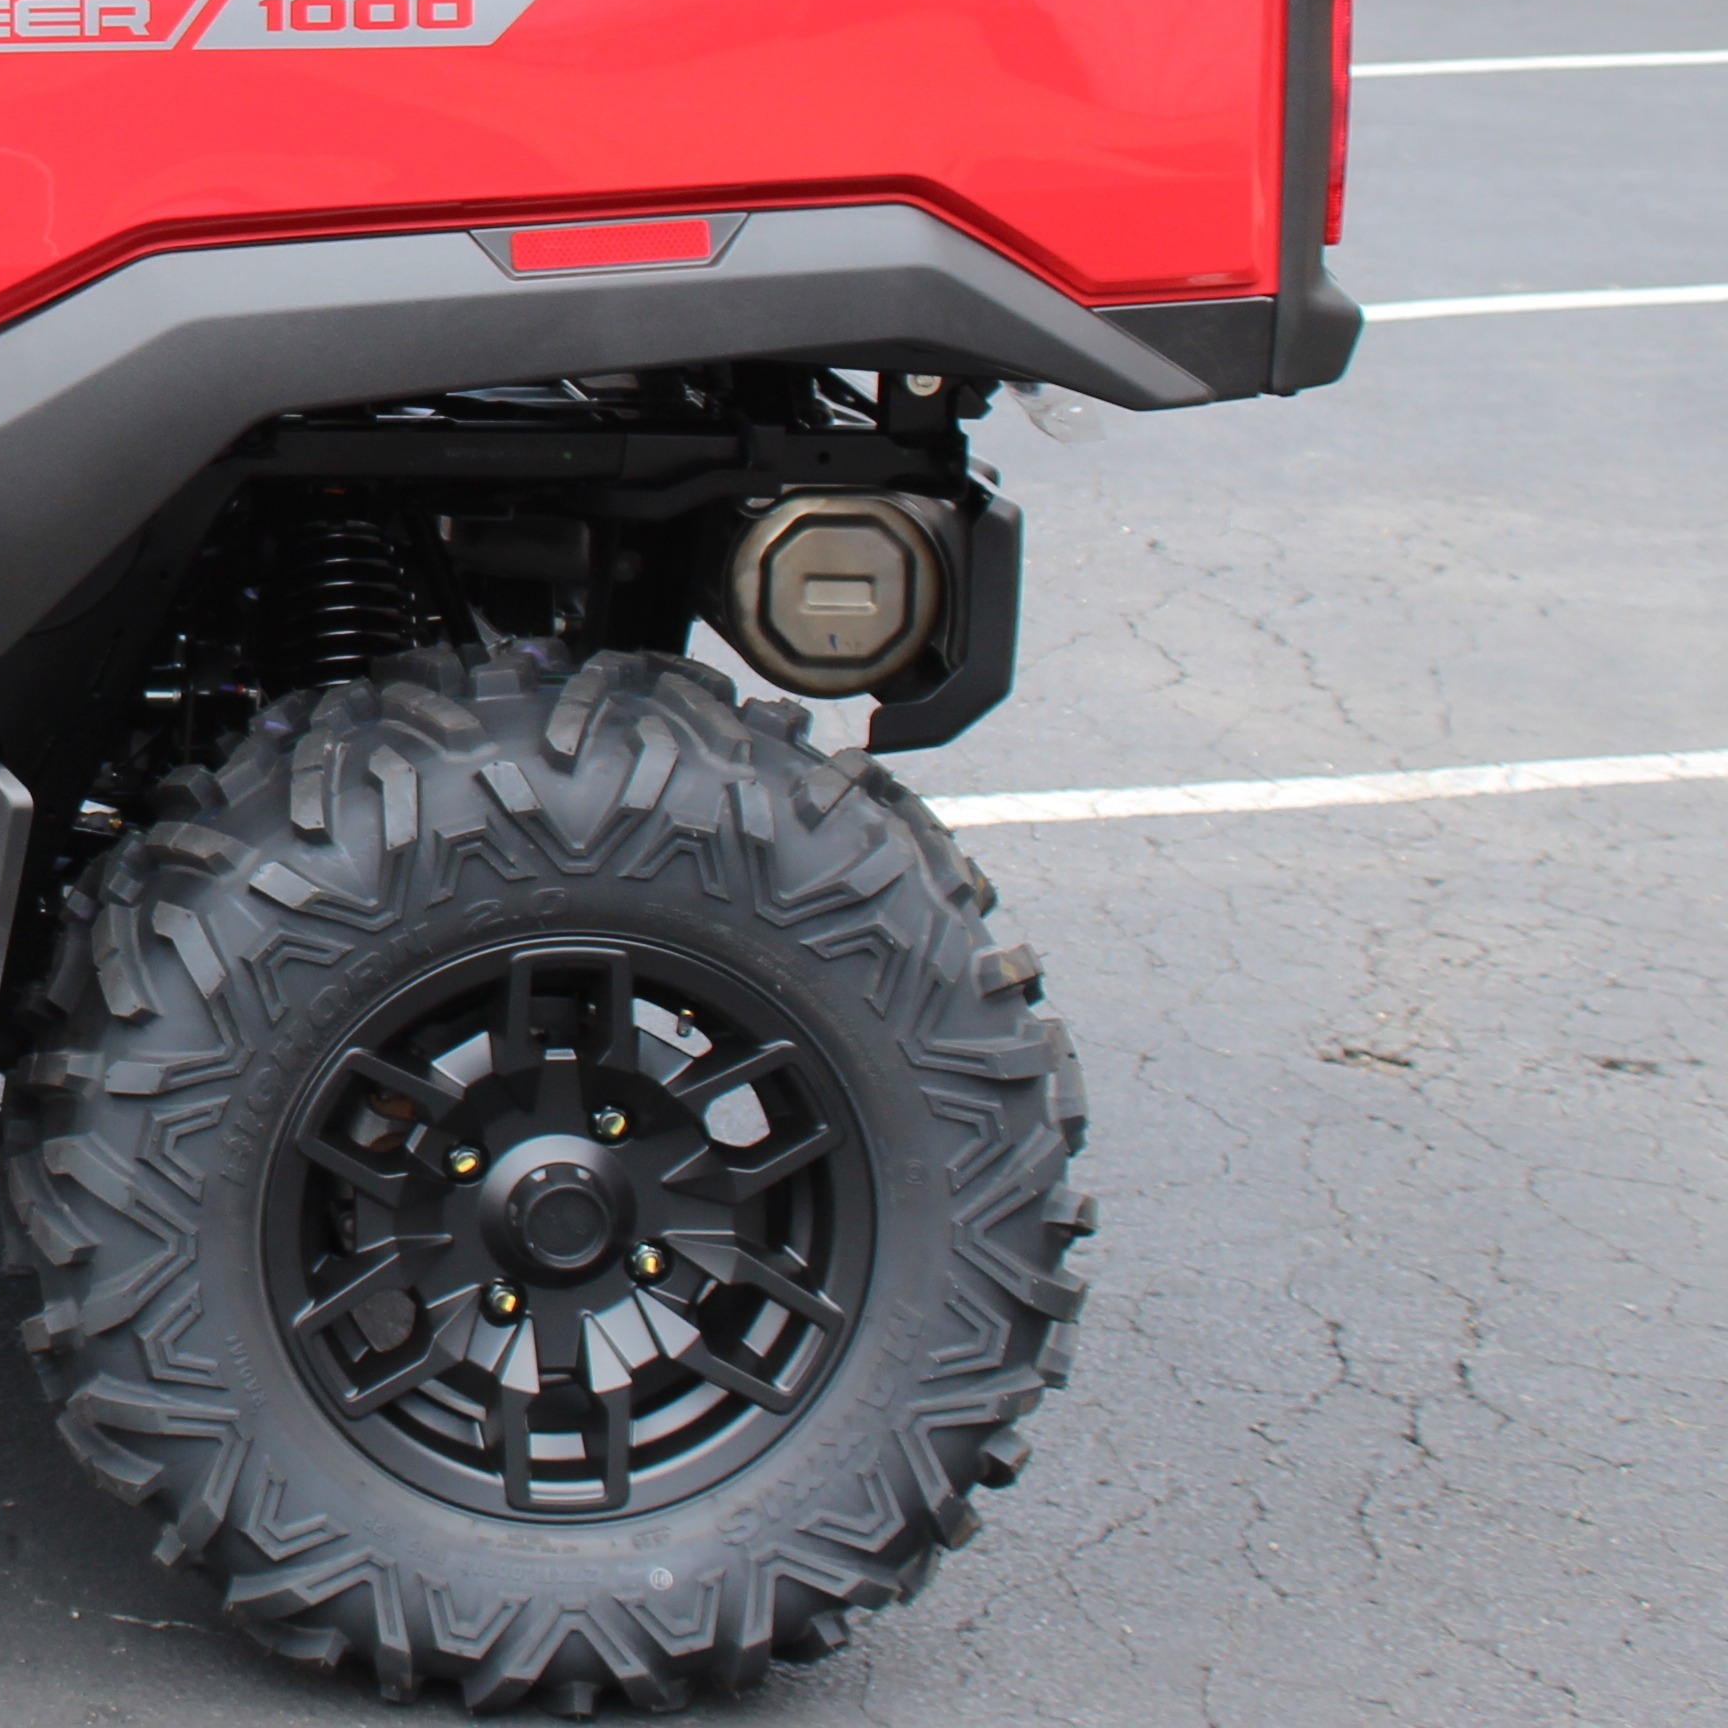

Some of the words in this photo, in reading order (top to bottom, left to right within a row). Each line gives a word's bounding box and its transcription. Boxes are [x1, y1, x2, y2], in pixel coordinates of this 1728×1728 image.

[222, 922, 435, 1180] BIGHORN
[463, 885, 566, 931] 2.0
[718, 1303, 925, 1550] MAXXIS
